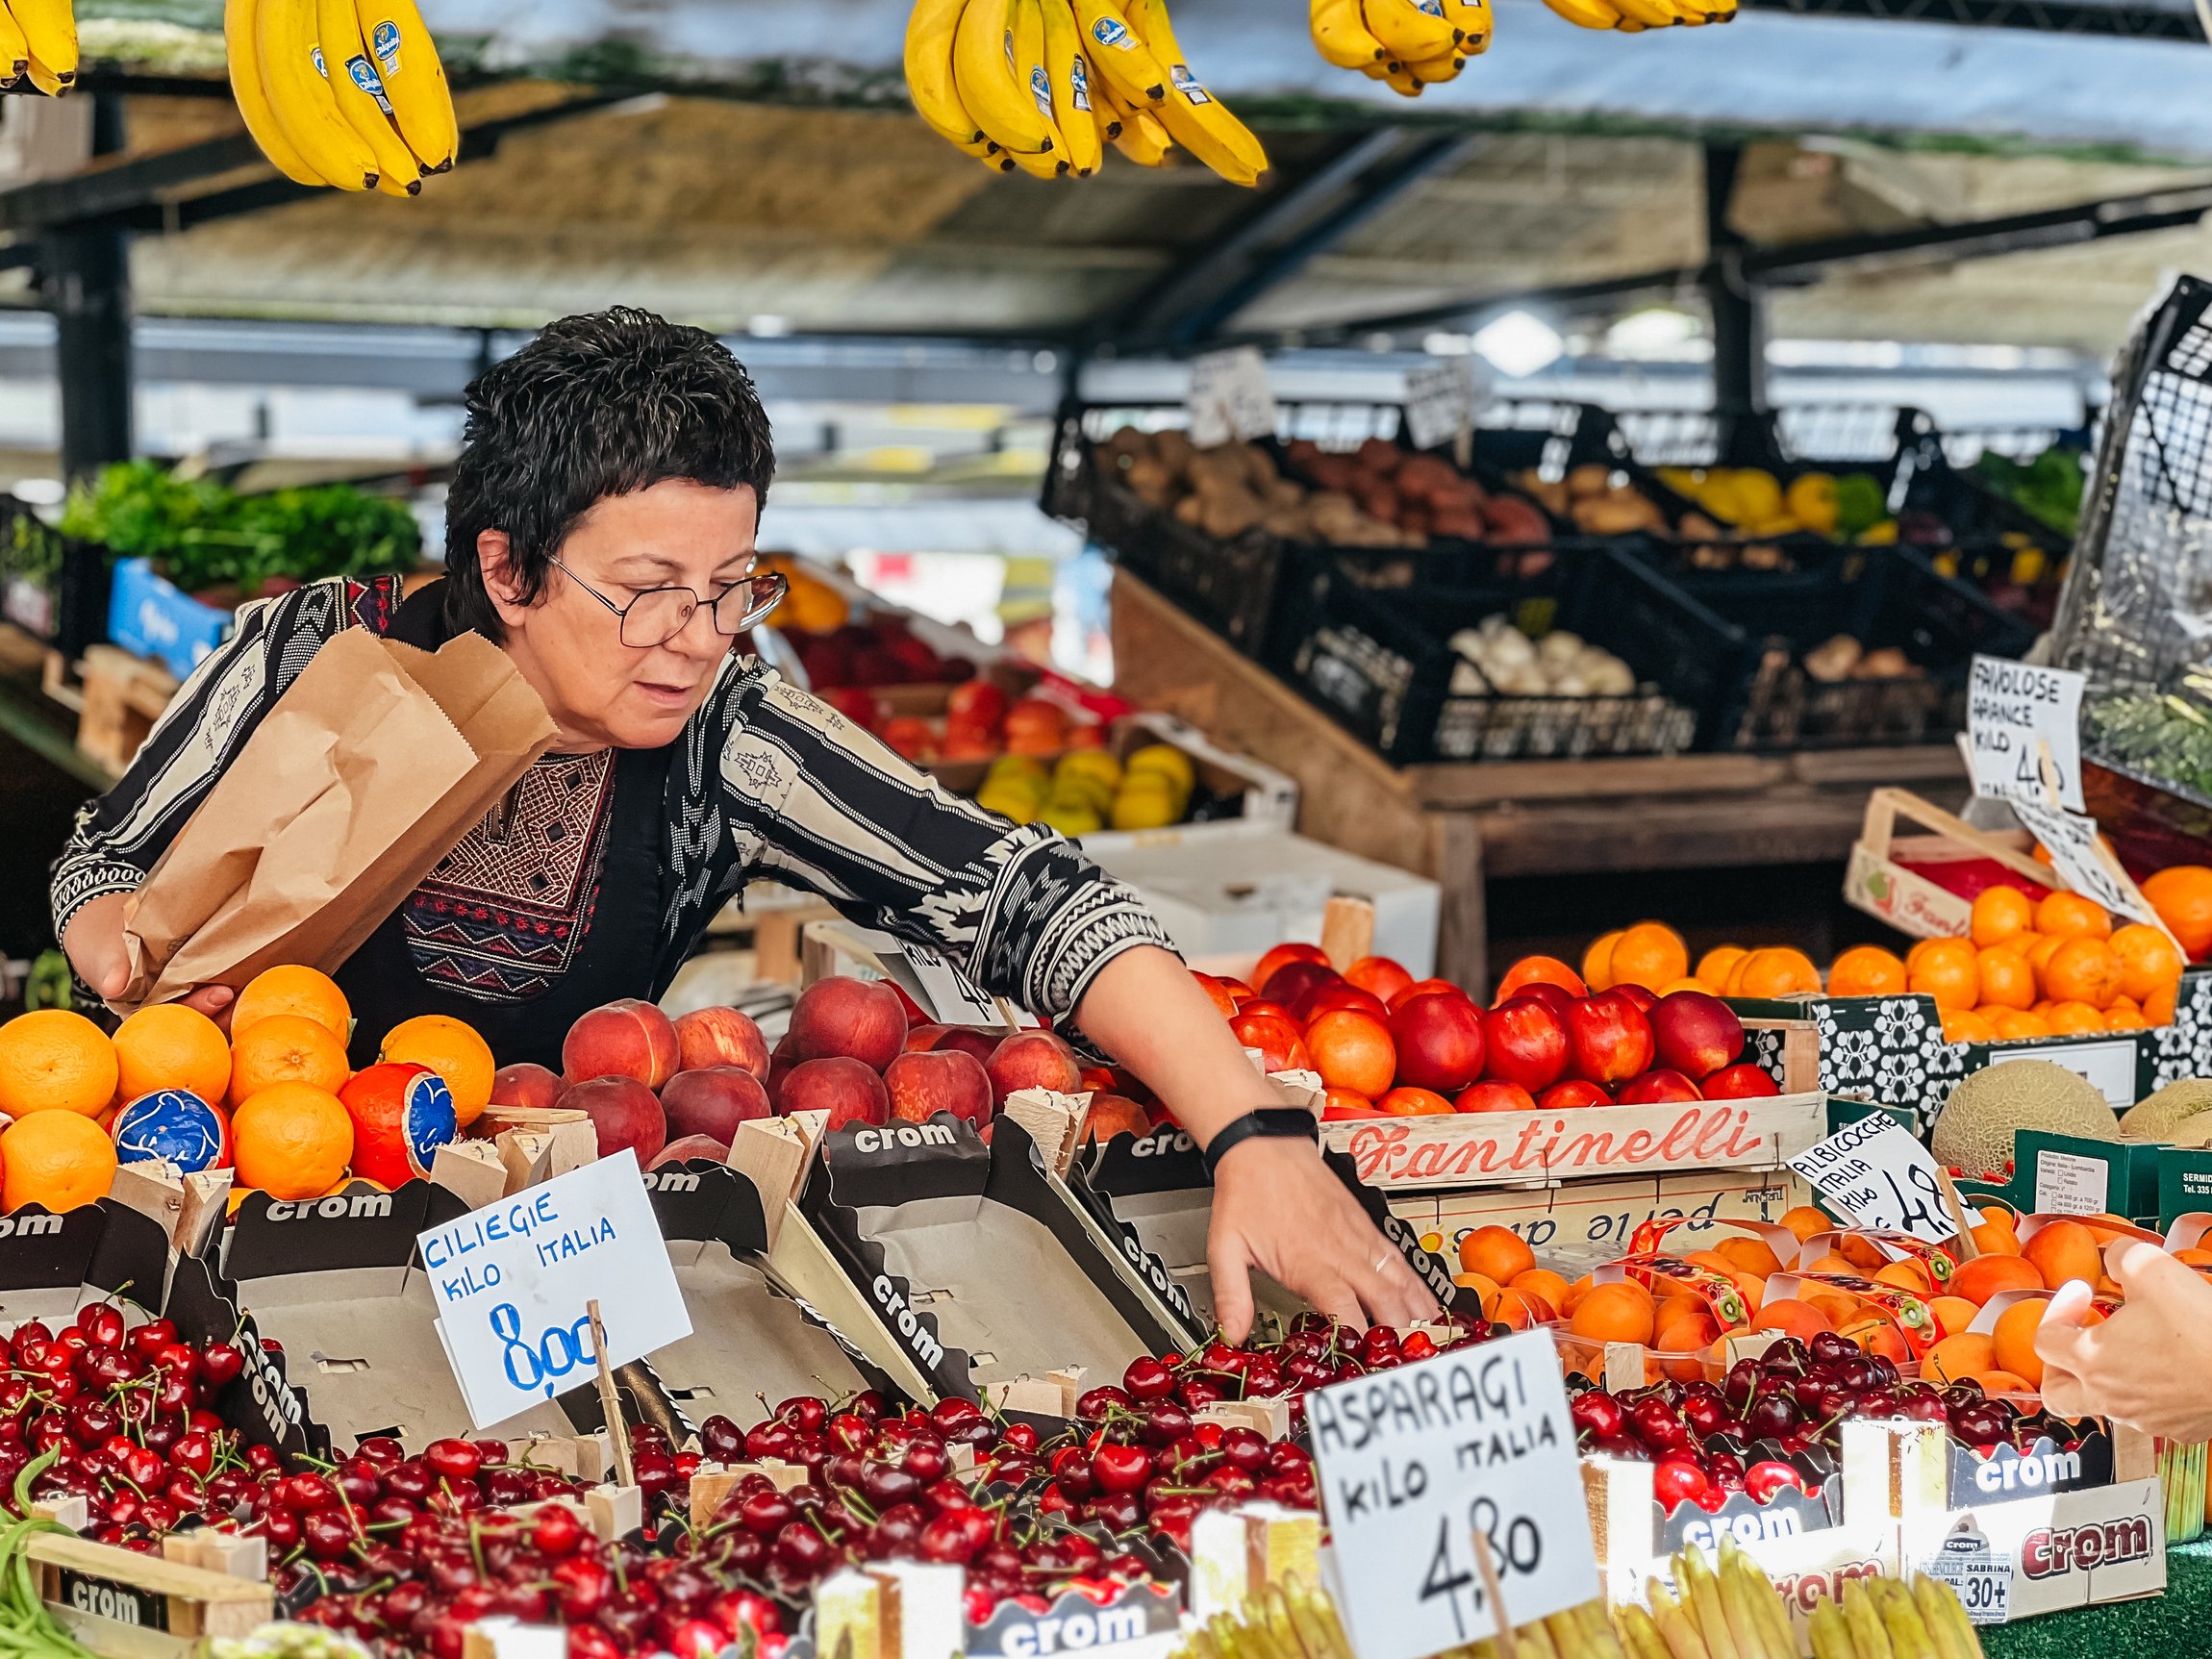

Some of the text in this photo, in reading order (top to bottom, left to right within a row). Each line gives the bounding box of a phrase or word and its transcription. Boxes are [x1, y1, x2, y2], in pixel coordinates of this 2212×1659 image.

[854, 1122, 957, 1153] crom
[1349, 1106, 1762, 1182] Fantinelli
[1792, 1112, 1898, 1178] ALBICOCCHE
[265, 1193, 393, 1222] crom
[1818, 1158, 1873, 1194] ITALIA
[424, 1192, 559, 1269] CILIEGIE
[441, 1217, 616, 1302] KILO ITALIA
[1383, 1216, 1456, 1306] crom
[1123, 1235, 1192, 1320] crom
[489, 1302, 608, 1399] 8,00
[872, 1274, 945, 1371] crom
[1312, 1354, 1526, 1456] ASPARAGI
[1339, 1412, 1557, 1525] KILO ITALIA
[1975, 1451, 2081, 1492] crom
[1682, 1506, 1800, 1551] crom
[72, 1580, 139, 1625] crom
[1419, 1496, 1543, 1640] 4,80
[1966, 1564, 2011, 1573] SABRINA
[1966, 1576, 2006, 1608] 30+
[1000, 1604, 1147, 1658] crom
